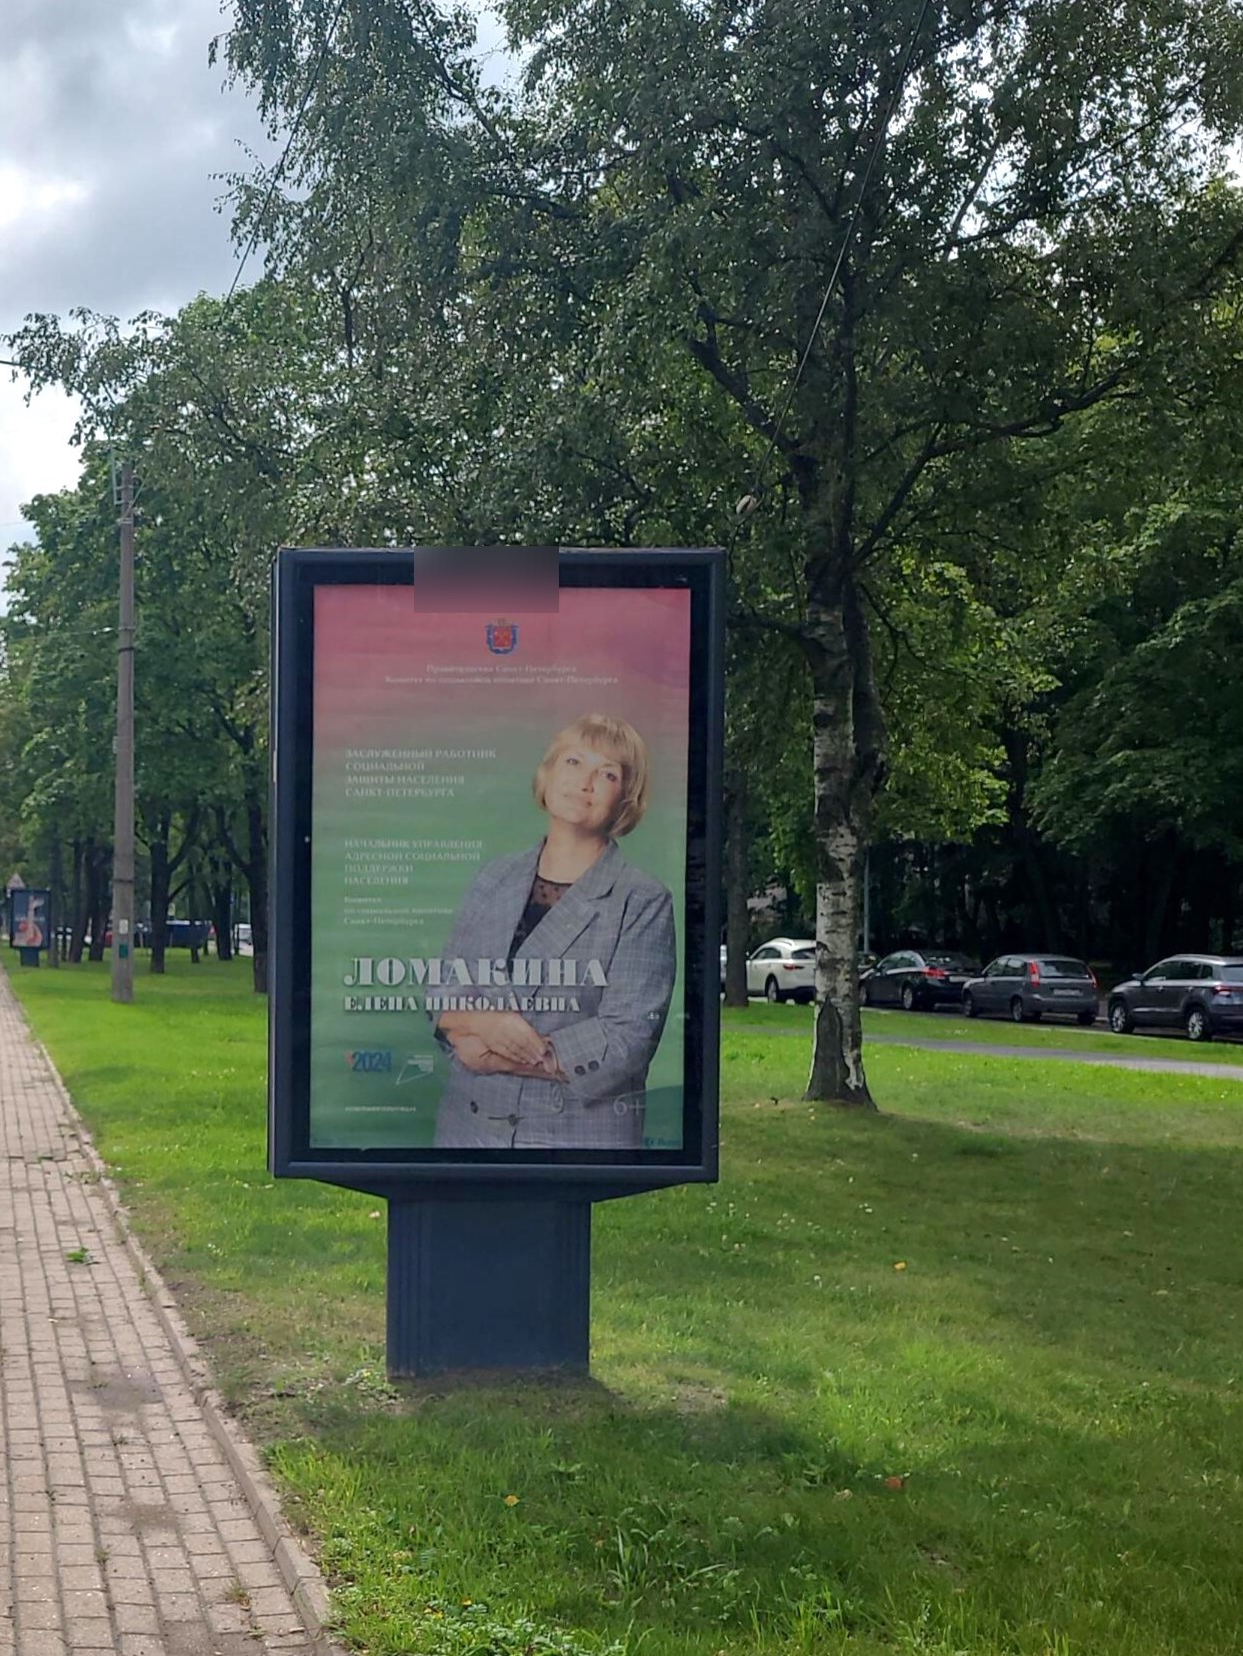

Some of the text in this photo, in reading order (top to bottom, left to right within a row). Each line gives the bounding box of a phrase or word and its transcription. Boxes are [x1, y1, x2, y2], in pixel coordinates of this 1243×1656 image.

[435, 749, 497, 759] РАБОТНИК
[345, 761, 425, 772] СОЦИАЛЬНОЙ
[396, 774, 465, 785] НАСЕЛЕНИЯ
[404, 851, 481, 862] СОЦИАЛЬНОЙ
[344, 876, 409, 885] НАСЕЛЕНИЯ
[343, 957, 609, 987] ЛОМАКИНА
[344, 995, 581, 1012] ЕЛЕНА НИКОЛАЕВНА
[352, 1050, 392, 1073] 2024
[613, 1093, 645, 1116] 6+
